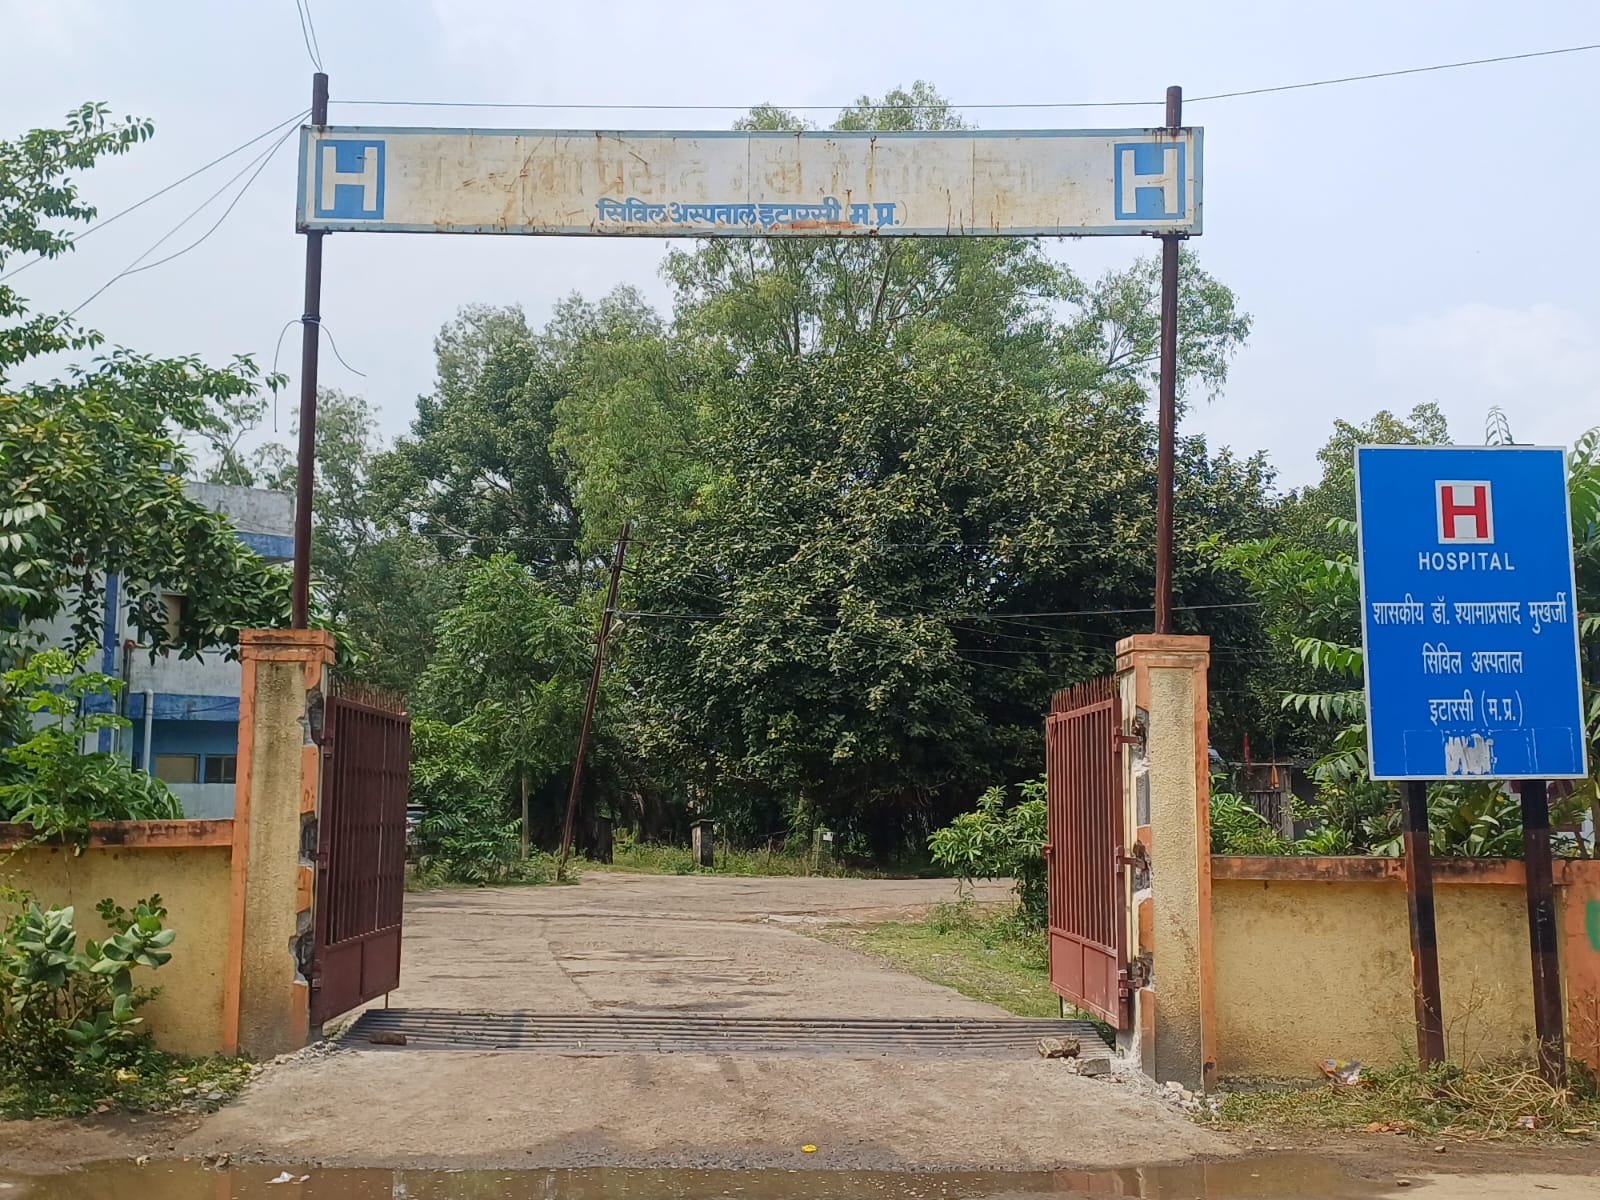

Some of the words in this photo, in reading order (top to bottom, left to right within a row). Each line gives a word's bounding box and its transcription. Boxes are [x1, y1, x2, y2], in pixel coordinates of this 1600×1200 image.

[321, 146, 378, 211] H
[1121, 148, 1178, 214] H
[597, 197, 670, 223] सिविल
[668, 203, 757, 225] अस्पताल
[1441, 486, 1488, 538] H
[1418, 551, 1515, 570] HOSPITAL
[1371, 593, 1424, 625] शासकीय
[1431, 596, 1450, 625] डॉ.
[1453, 601, 1521, 625] श्यामाप्रसाद
[1527, 592, 1567, 634] मुखर्जी
[1422, 642, 1462, 674] सिविल
[1470, 651, 1523, 673] अस्पताल
[1428, 689, 1474, 725] इटारसी
[1481, 690, 1523, 727] (म.प्र.)
